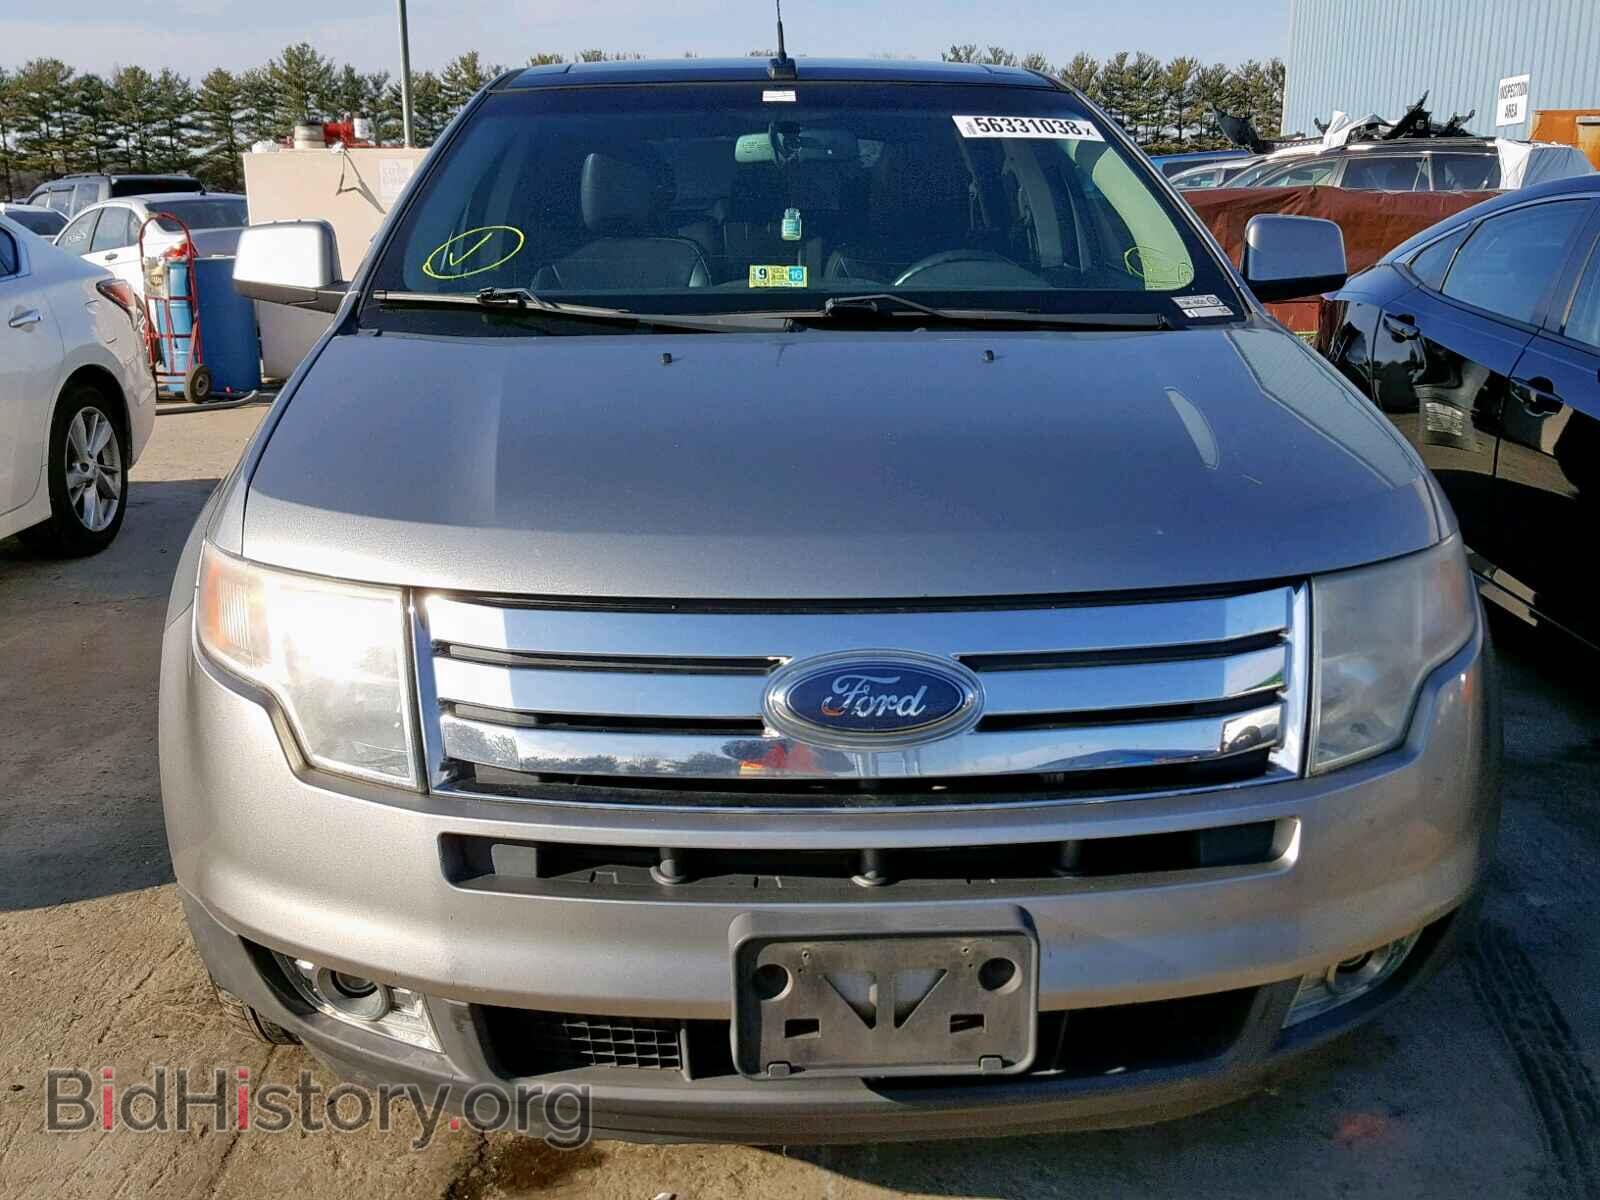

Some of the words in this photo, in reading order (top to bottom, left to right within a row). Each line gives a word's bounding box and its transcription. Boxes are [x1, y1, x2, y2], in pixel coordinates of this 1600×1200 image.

[1499, 82, 1528, 100] INSPECTION
[1504, 103, 1518, 119] AREA
[974, 117, 1082, 135] 56331038
[759, 268, 768, 280] 9
[821, 675, 928, 717] Ford
